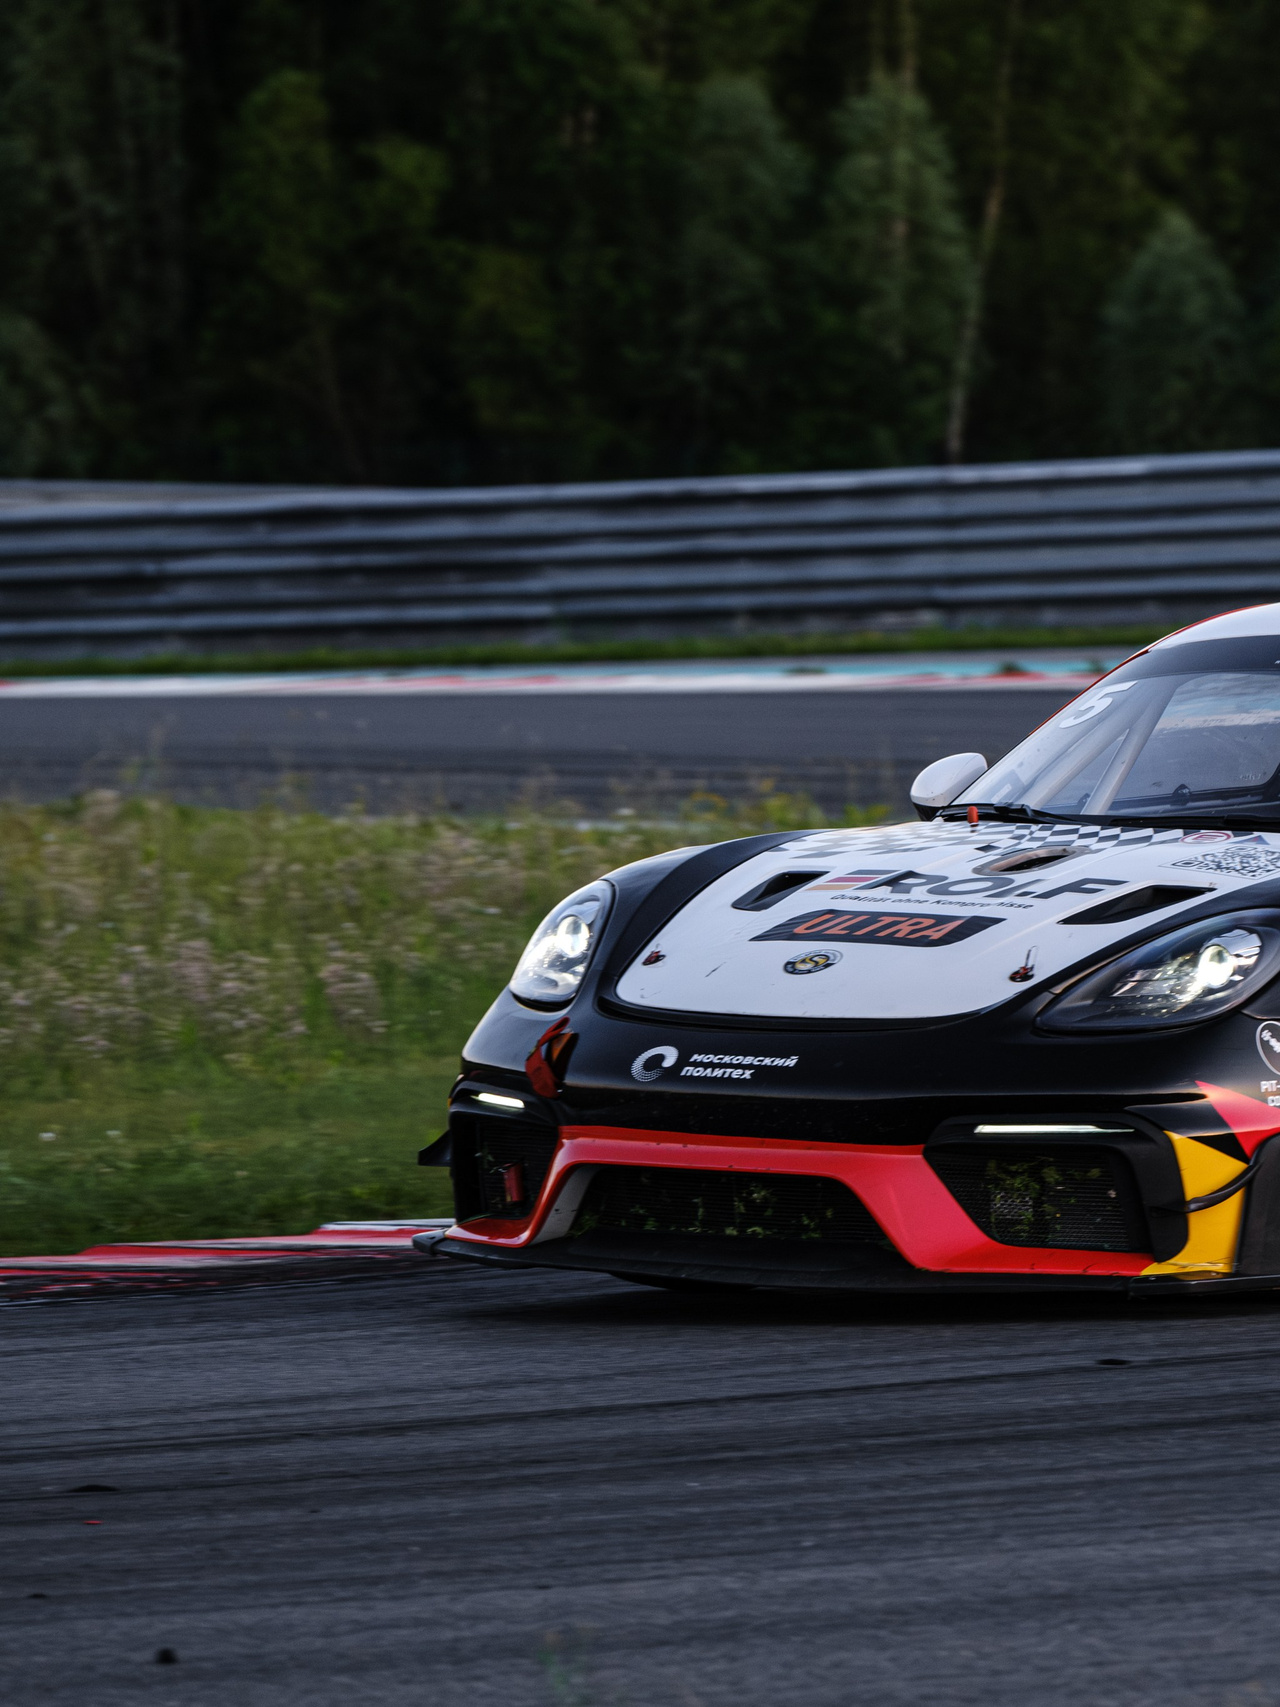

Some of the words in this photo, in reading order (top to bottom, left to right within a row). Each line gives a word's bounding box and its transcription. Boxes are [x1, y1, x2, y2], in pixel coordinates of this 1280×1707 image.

[1059, 681, 1138, 729] 5
[852, 869, 1130, 900] ROLF
[891, 896, 928, 905] ohne
[792, 914, 965, 940] ULTRA
